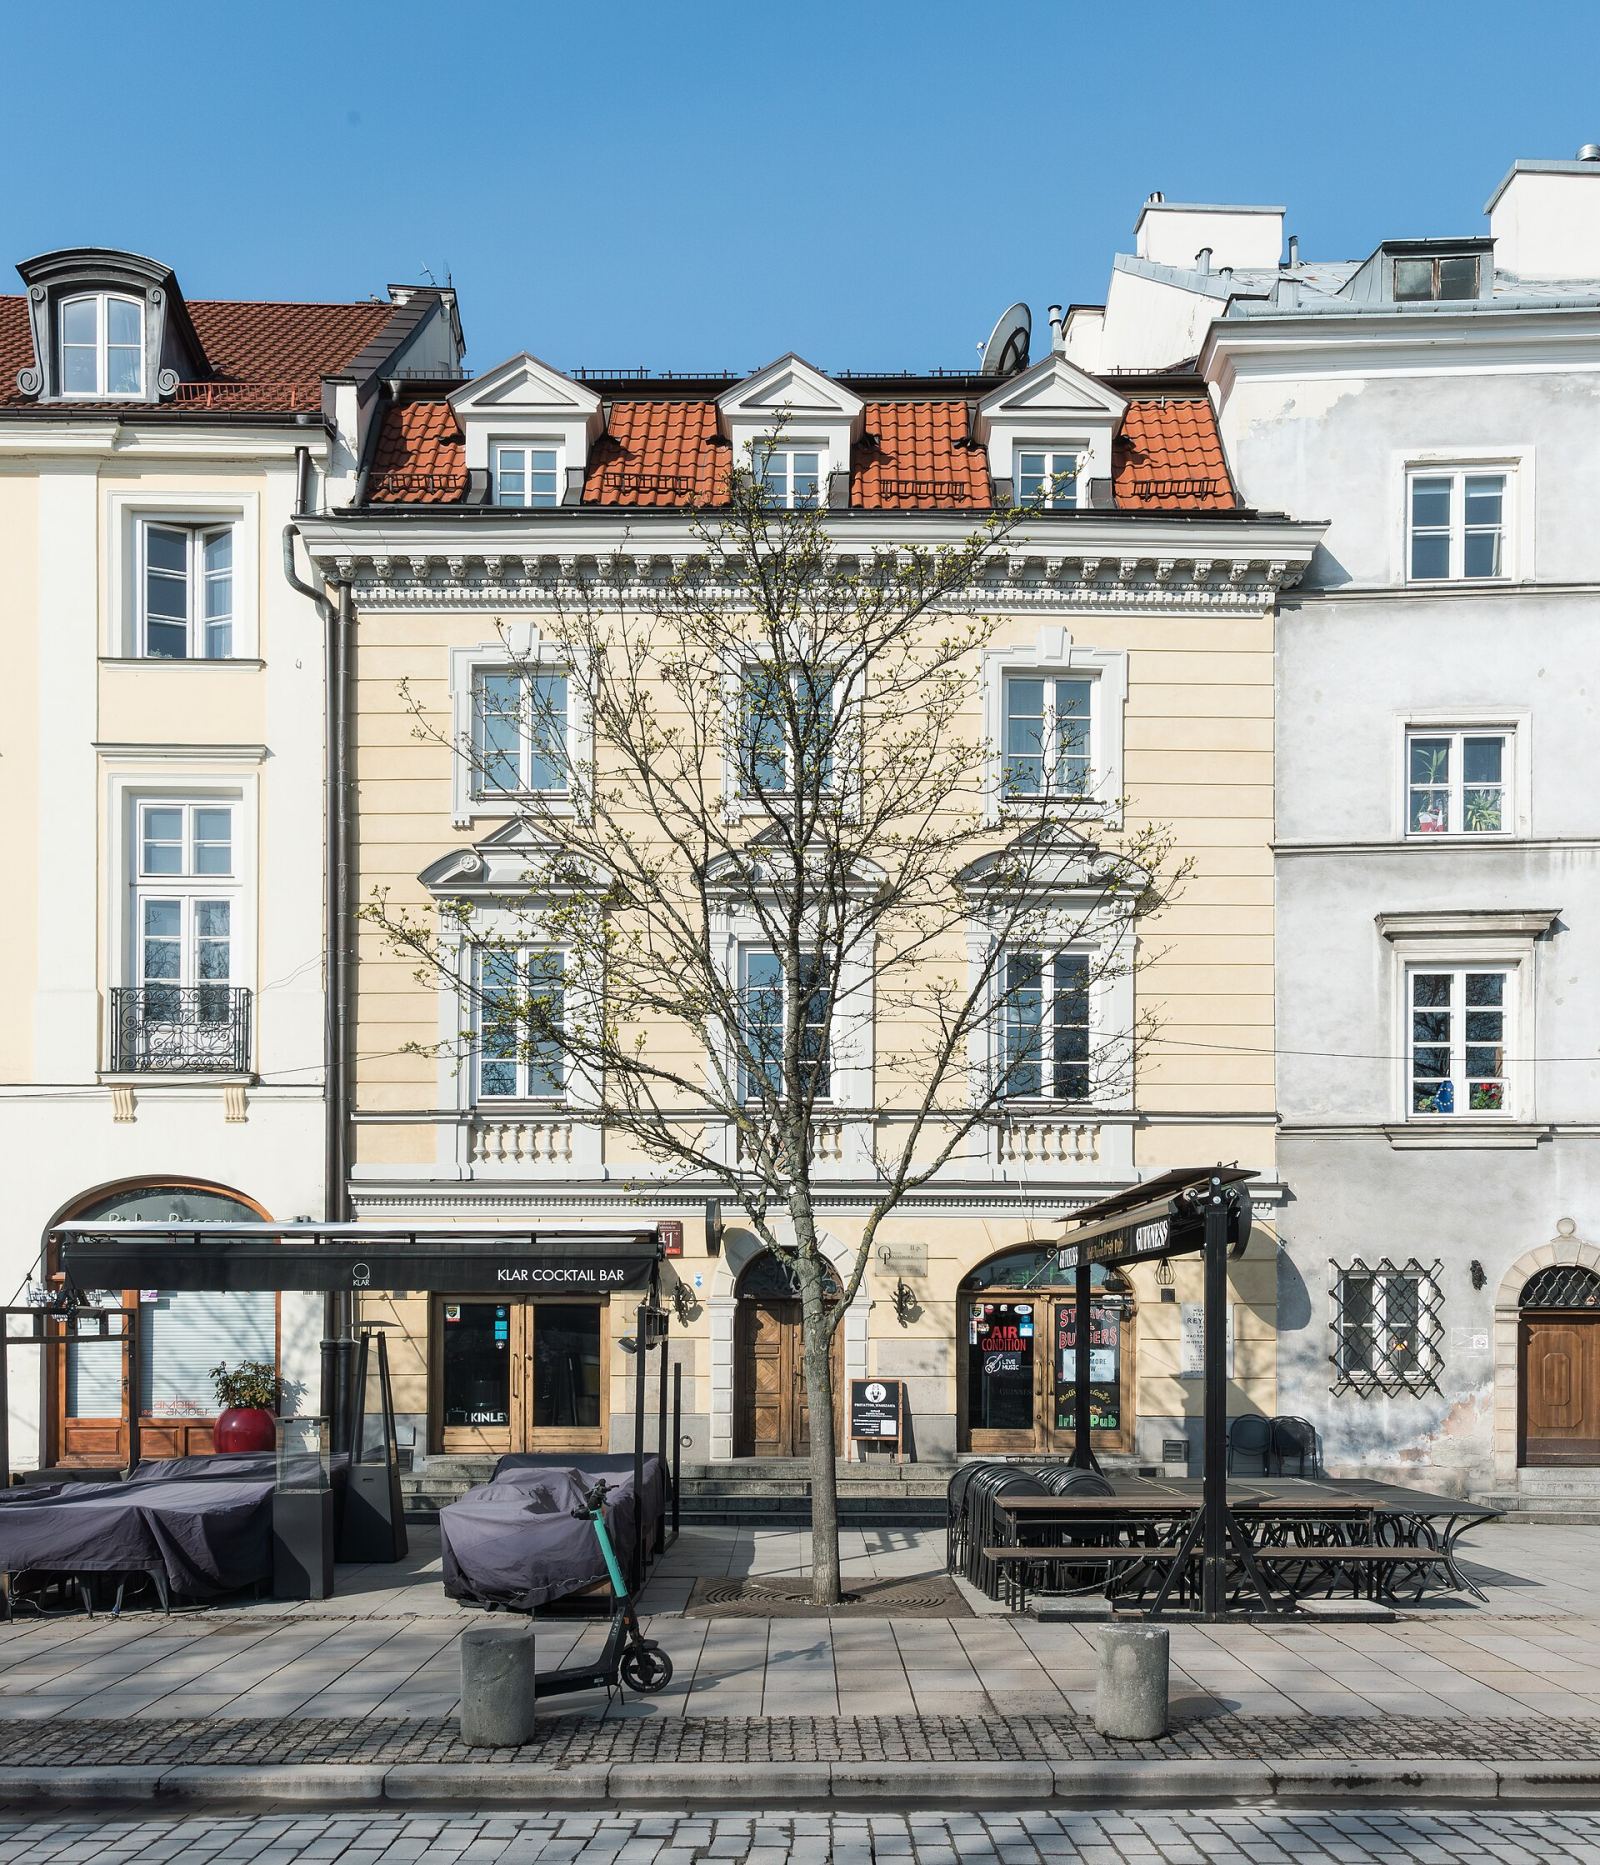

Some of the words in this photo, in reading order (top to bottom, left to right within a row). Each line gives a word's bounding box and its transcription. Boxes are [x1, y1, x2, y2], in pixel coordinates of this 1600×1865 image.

[1135, 1220, 1168, 1252] GUINNESS
[497, 1269, 528, 1281] KLAR
[532, 1269, 596, 1281] COCKTAIL
[599, 1269, 625, 1281] BAR
[1060, 1308, 1114, 1328] STAKS
[991, 1326, 1018, 1338] AIR
[981, 1338, 1027, 1351] CONDITION
[1089, 1414, 1117, 1428] Pub
